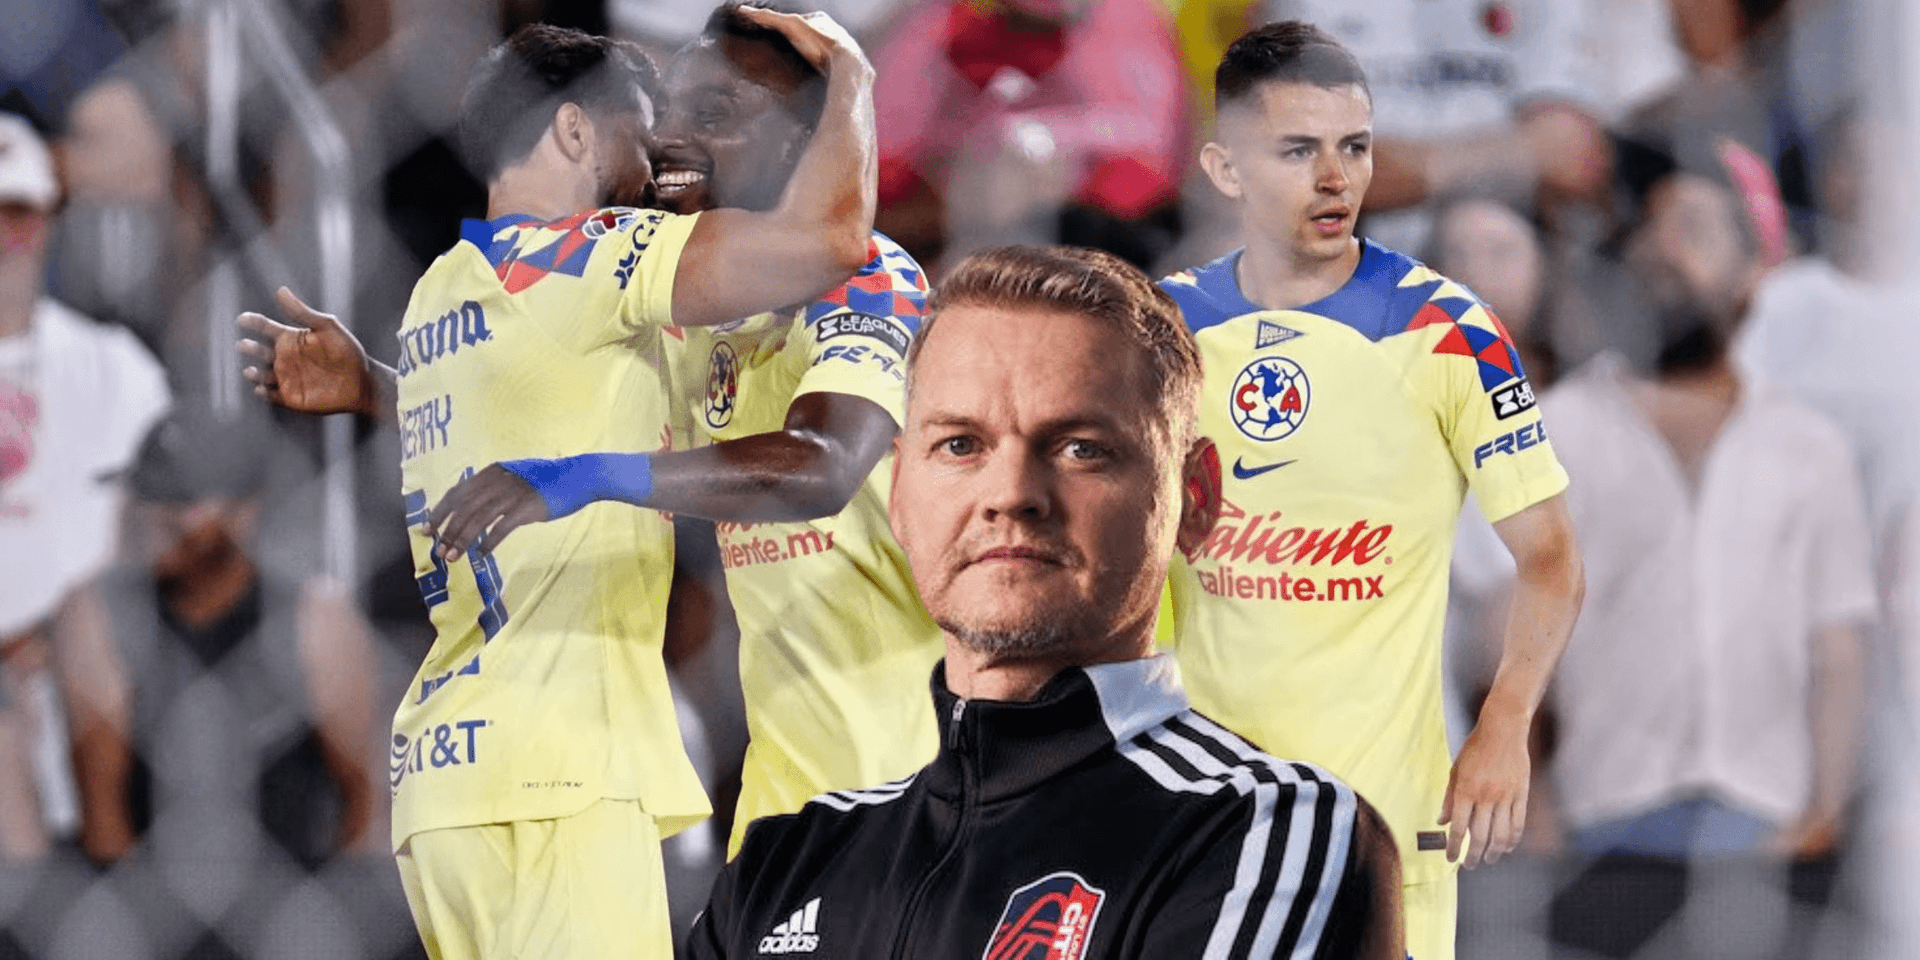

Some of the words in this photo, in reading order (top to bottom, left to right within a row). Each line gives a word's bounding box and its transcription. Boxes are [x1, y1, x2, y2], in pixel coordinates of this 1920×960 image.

[399, 300, 491, 377] orona
[840, 323, 875, 333] CUP
[840, 315, 906, 347] LEAGUES
[1236, 383, 1260, 411] C
[1279, 385, 1302, 413] A
[758, 934, 820, 955] adidas
[1053, 902, 1082, 960] CIT
